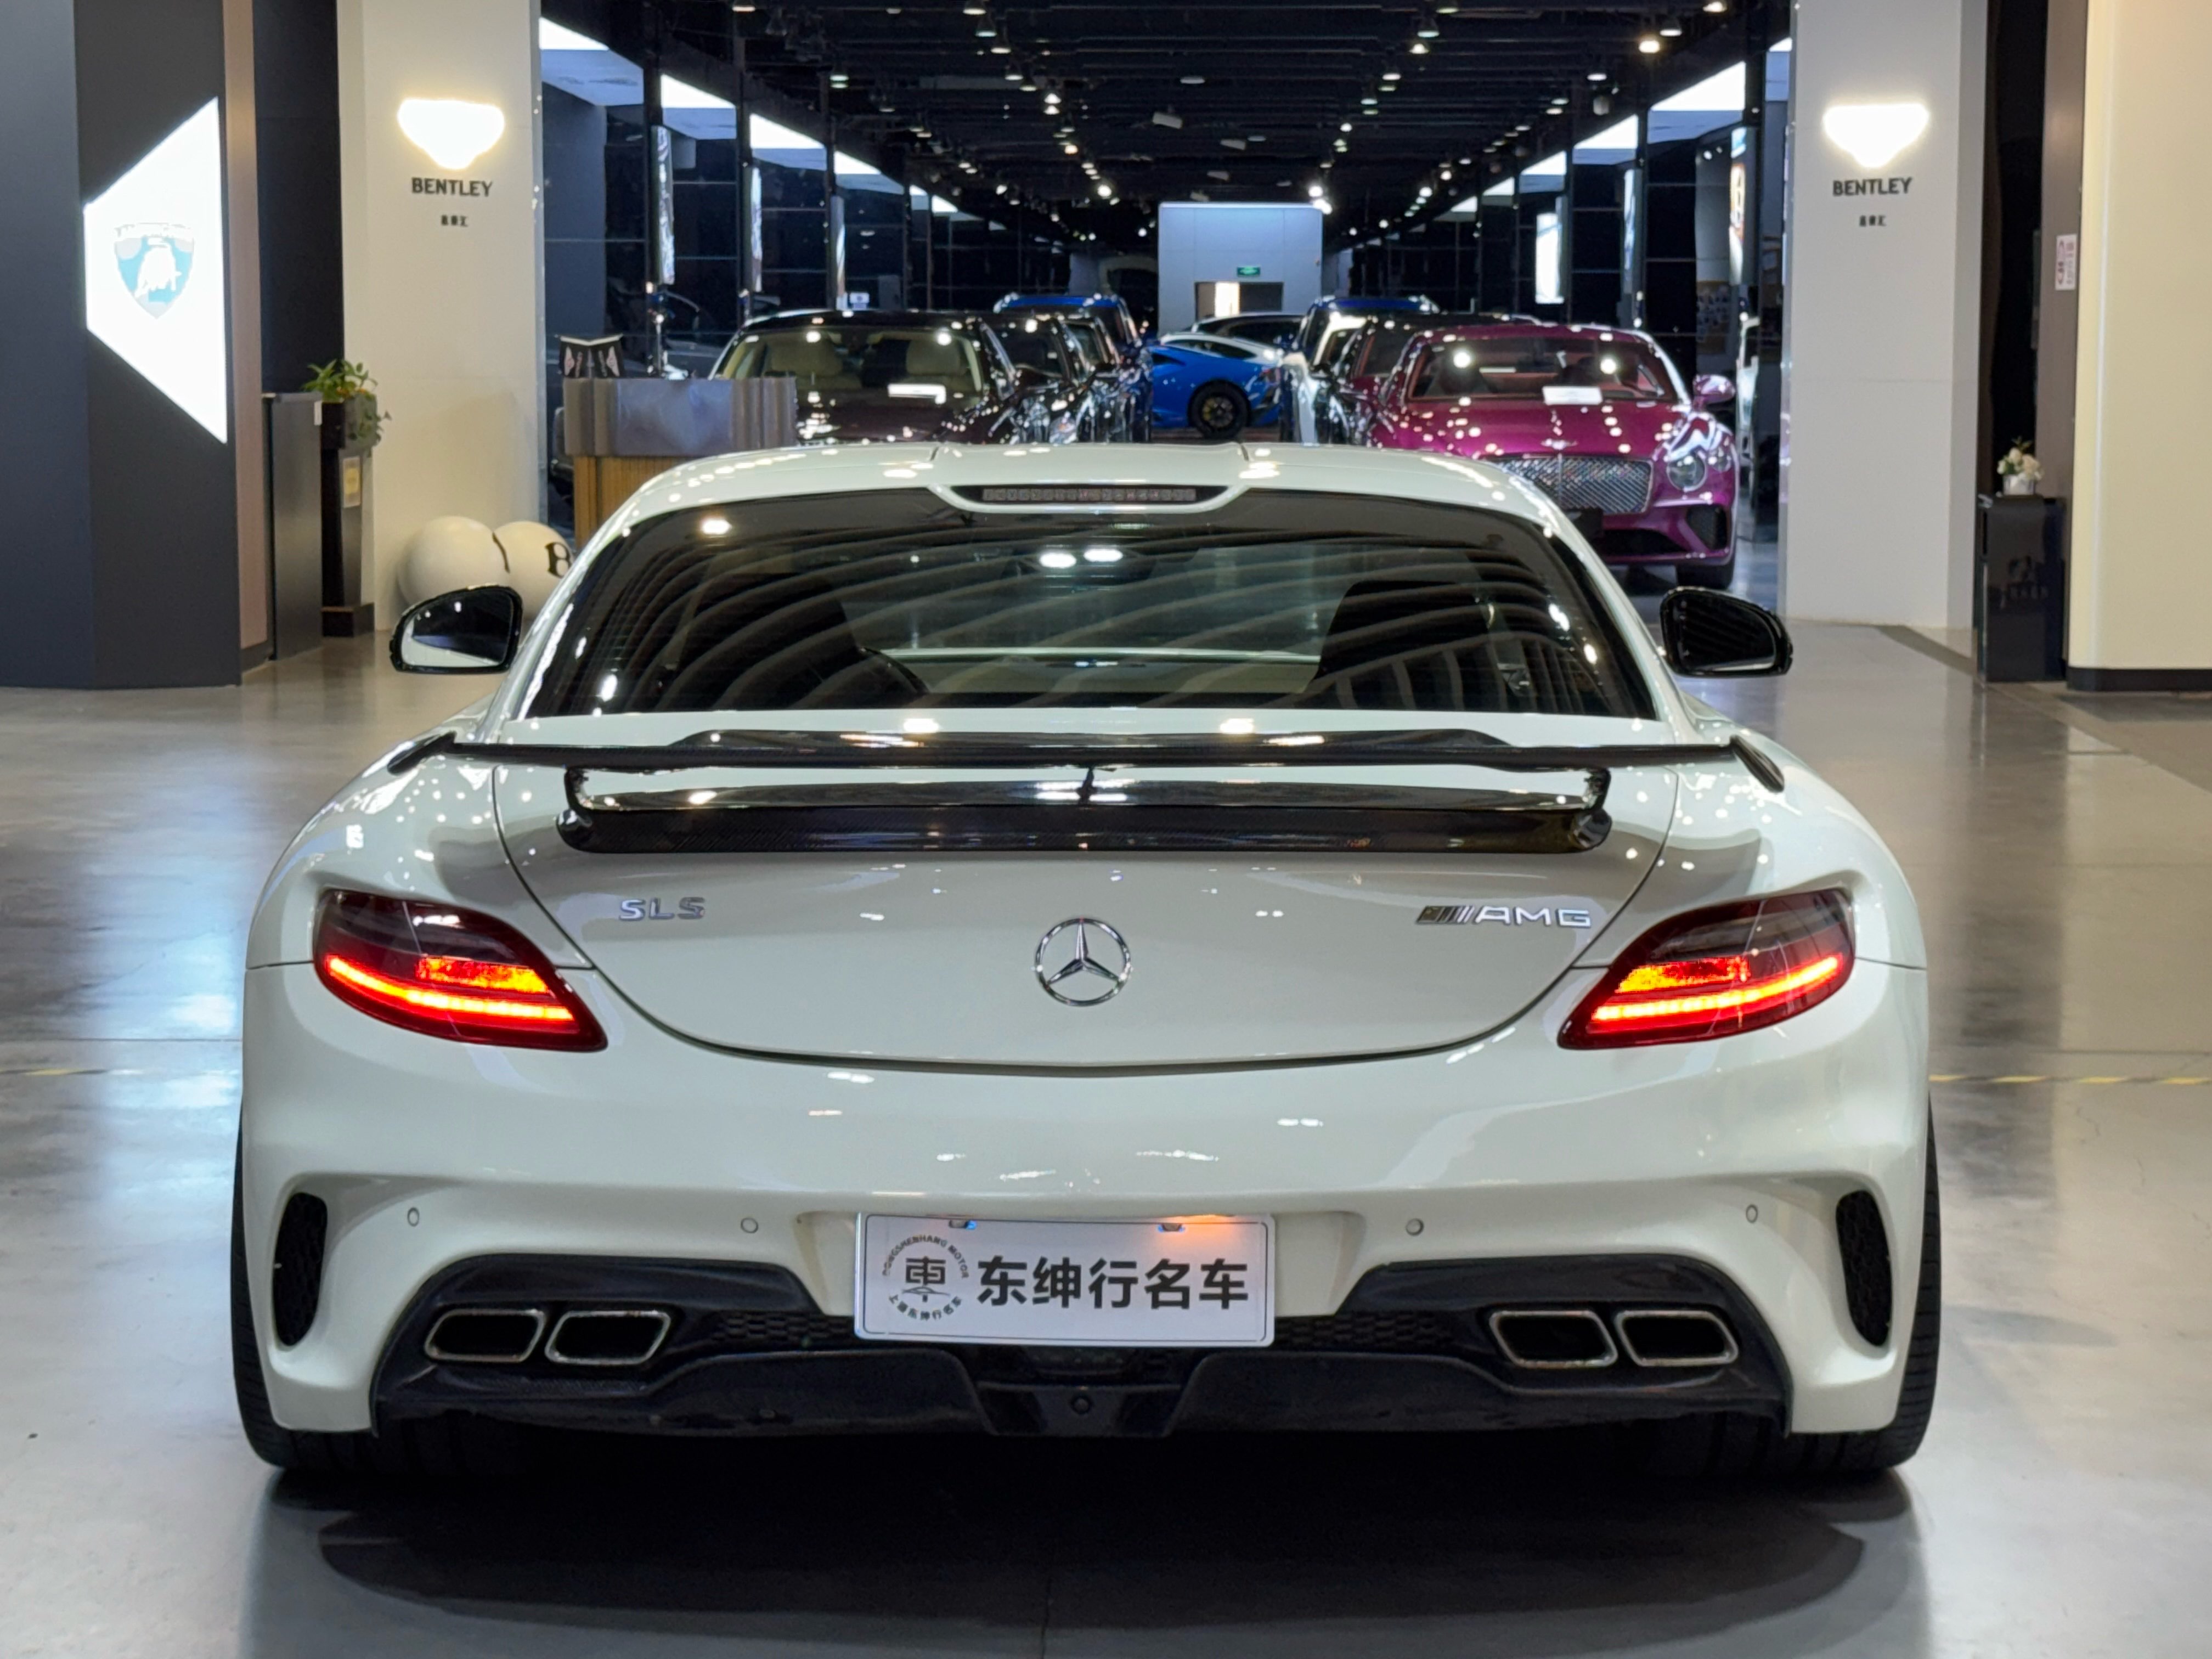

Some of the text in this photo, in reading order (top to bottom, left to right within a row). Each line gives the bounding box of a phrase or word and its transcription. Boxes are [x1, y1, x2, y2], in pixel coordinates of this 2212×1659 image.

[411, 177, 493, 198] BENTLEY
[1833, 176, 1912, 197] BENTLEY
[544, 541, 572, 579] B
[619, 896, 706, 922] SLS
[1472, 906, 1591, 928] AMG
[947, 1244, 970, 1279] MOTOR
[977, 1255, 1249, 1310] 东绅行名车
